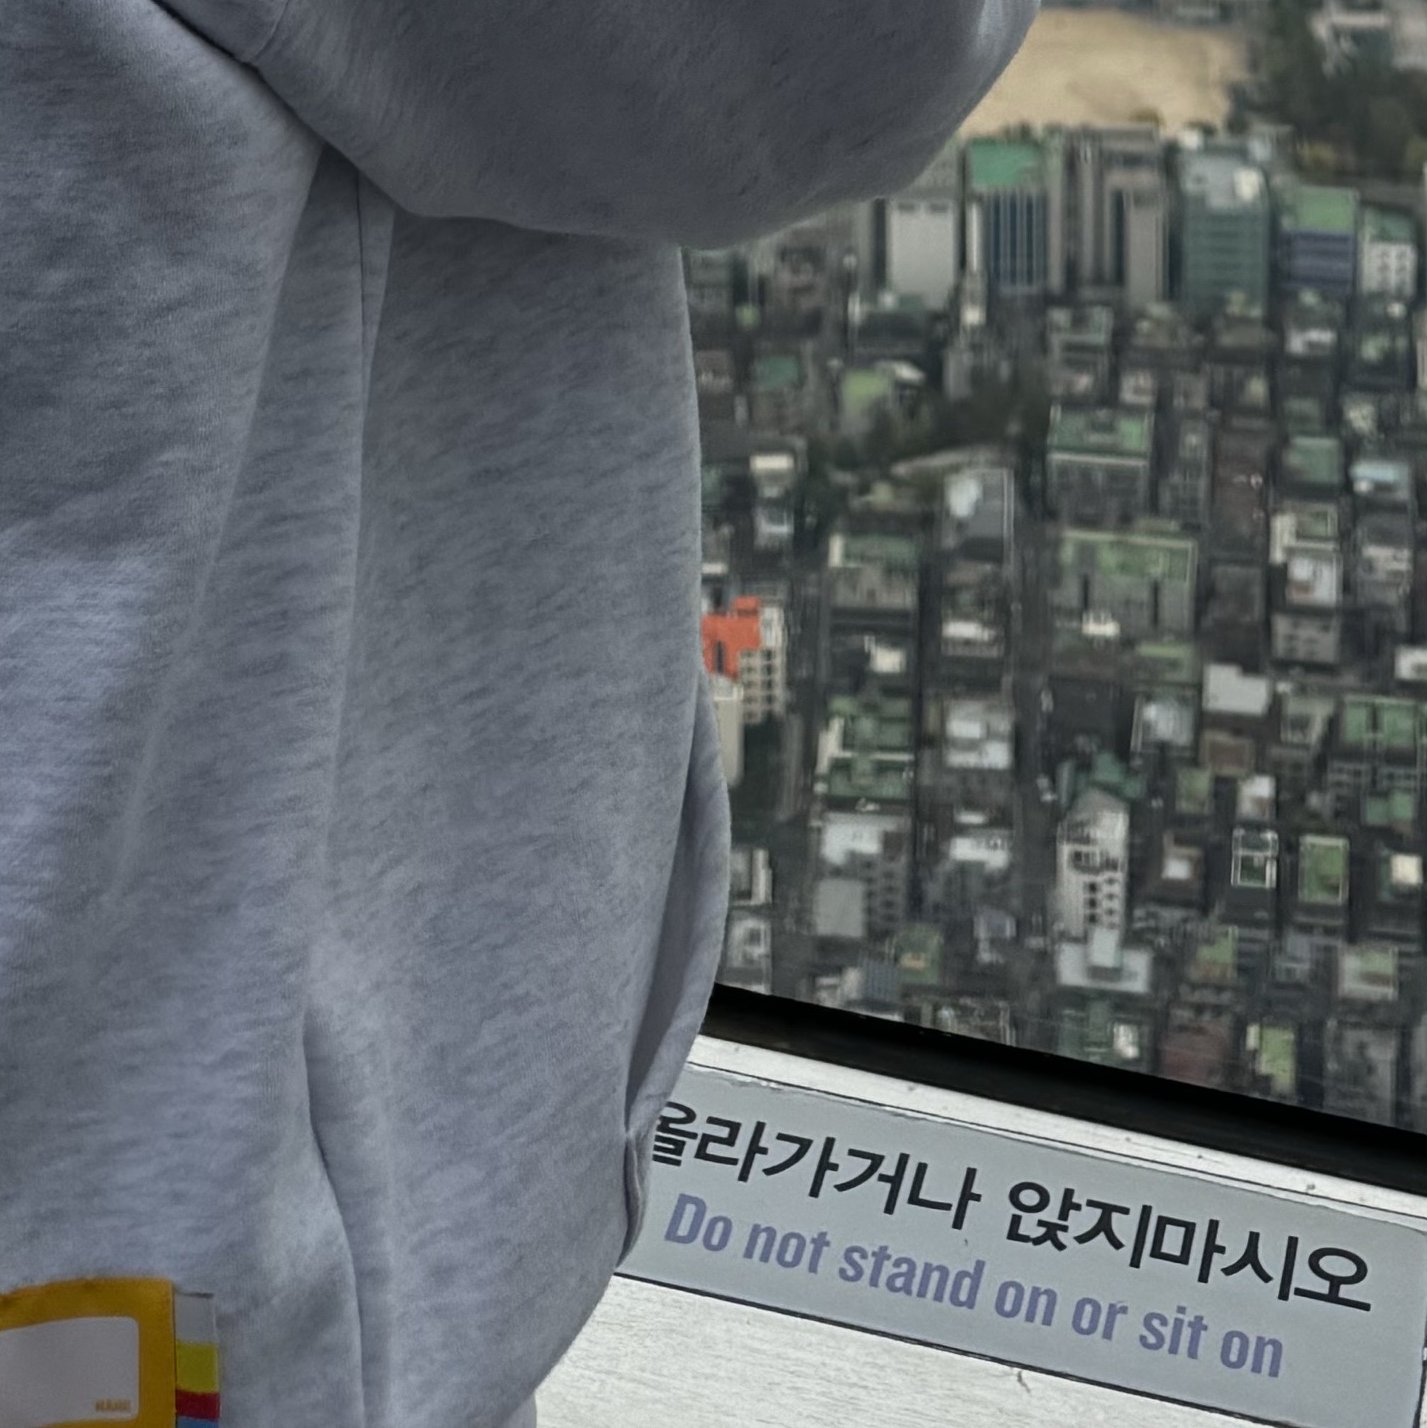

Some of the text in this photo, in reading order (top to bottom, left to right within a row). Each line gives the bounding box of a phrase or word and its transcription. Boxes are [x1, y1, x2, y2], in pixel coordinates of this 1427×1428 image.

[652, 1101, 1372, 1312] 올라가거나 앉지마시오
[664, 1193, 1284, 1378] Do not stand on or sit on
